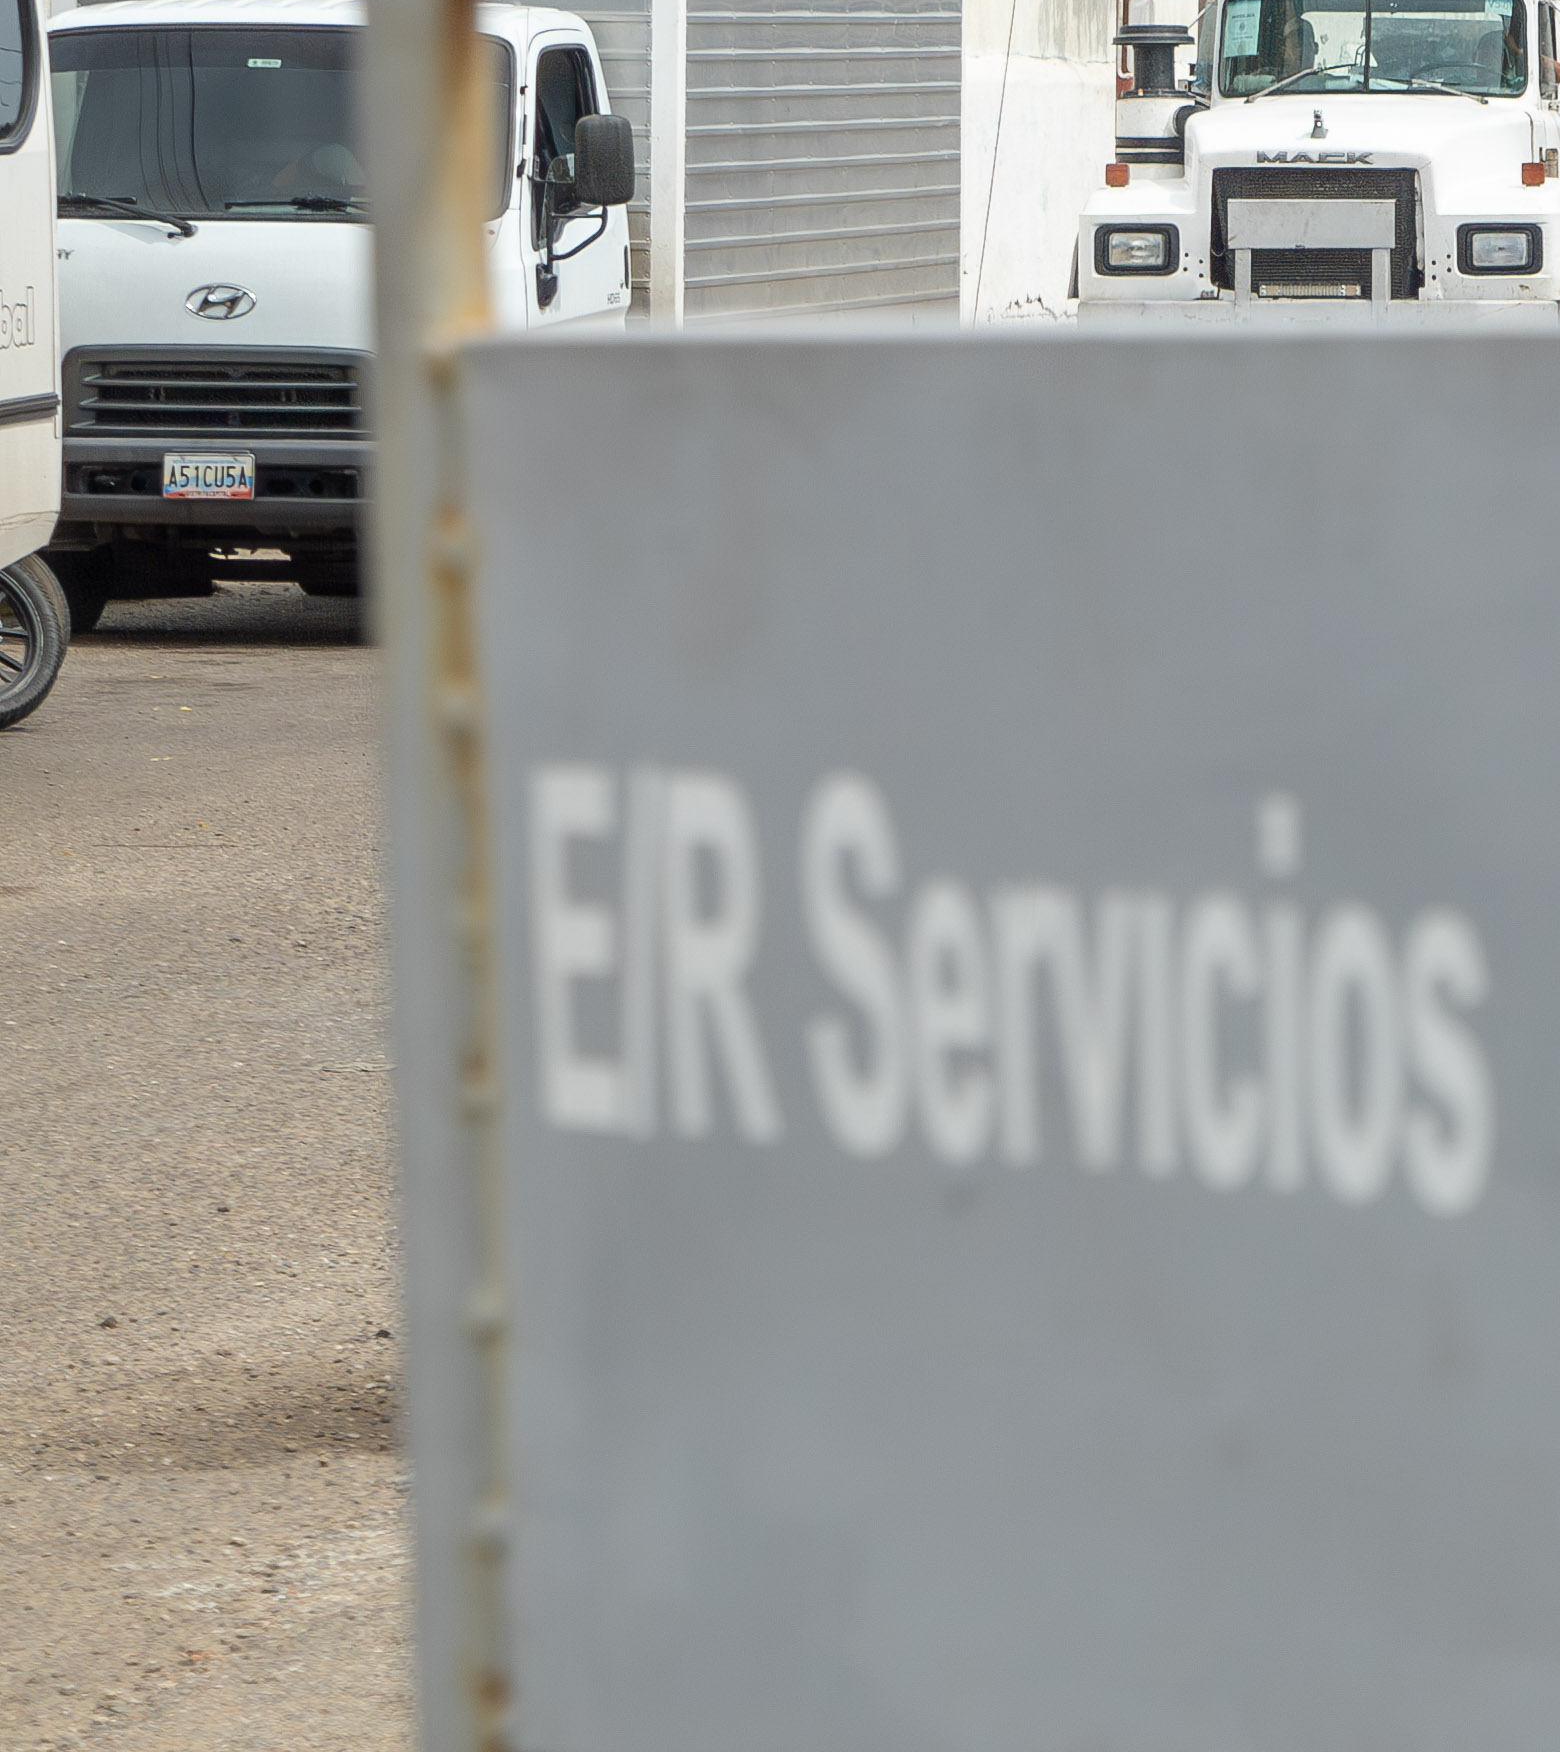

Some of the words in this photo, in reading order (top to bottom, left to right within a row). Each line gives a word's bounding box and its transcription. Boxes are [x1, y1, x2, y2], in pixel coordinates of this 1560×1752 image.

[1256, 150, 1374, 165] MACK
[168, 464, 248, 489] A51CU5A
[803, 768, 1498, 1220] Servicios
